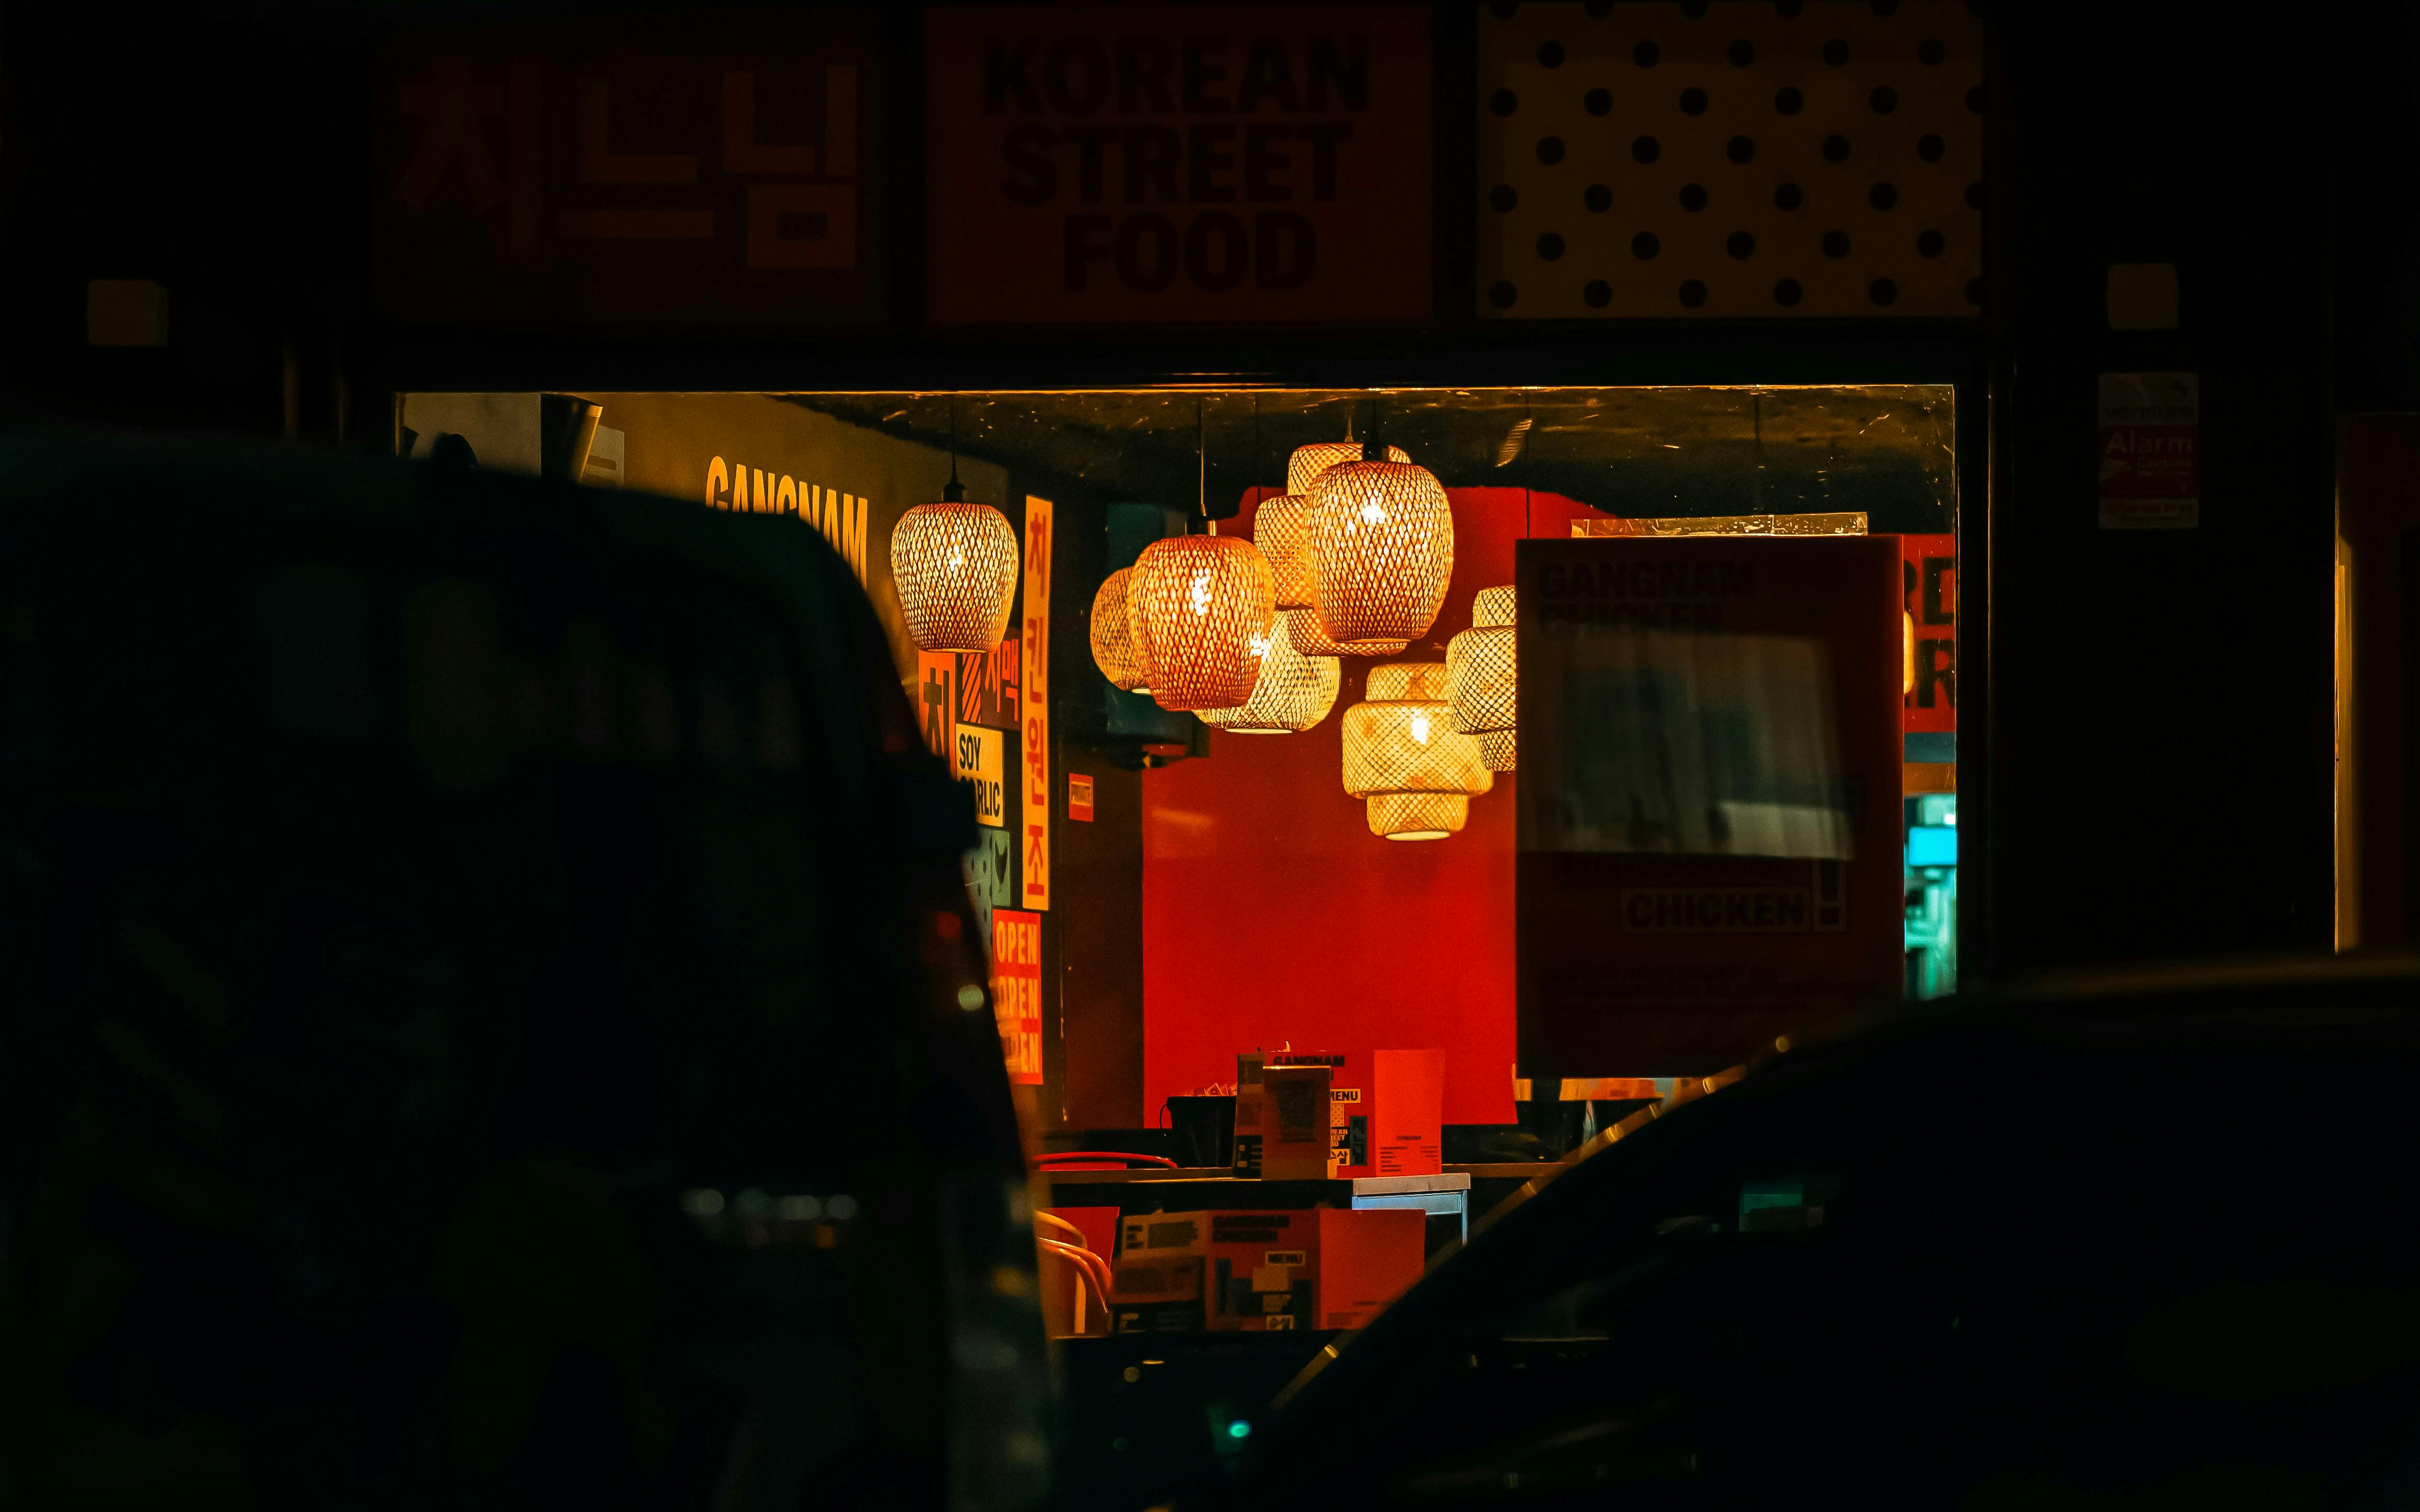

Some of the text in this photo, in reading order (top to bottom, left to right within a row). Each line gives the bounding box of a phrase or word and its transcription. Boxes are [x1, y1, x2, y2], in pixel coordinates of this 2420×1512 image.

[982, 35, 1368, 115] KOREAN
[393, 62, 858, 269] 치느님
[1002, 123, 1352, 204] STREET
[1065, 211, 1316, 293] FOOD
[2105, 429, 2192, 453] Alarm
[1538, 560, 1755, 598] GANGNAM
[959, 732, 981, 772] SOY
[962, 776, 1000, 818] RLIC
[1626, 892, 1804, 927] CHICKEN
[996, 921, 1037, 965] OPEN
[1273, 1055, 1345, 1067] GANGNAM
